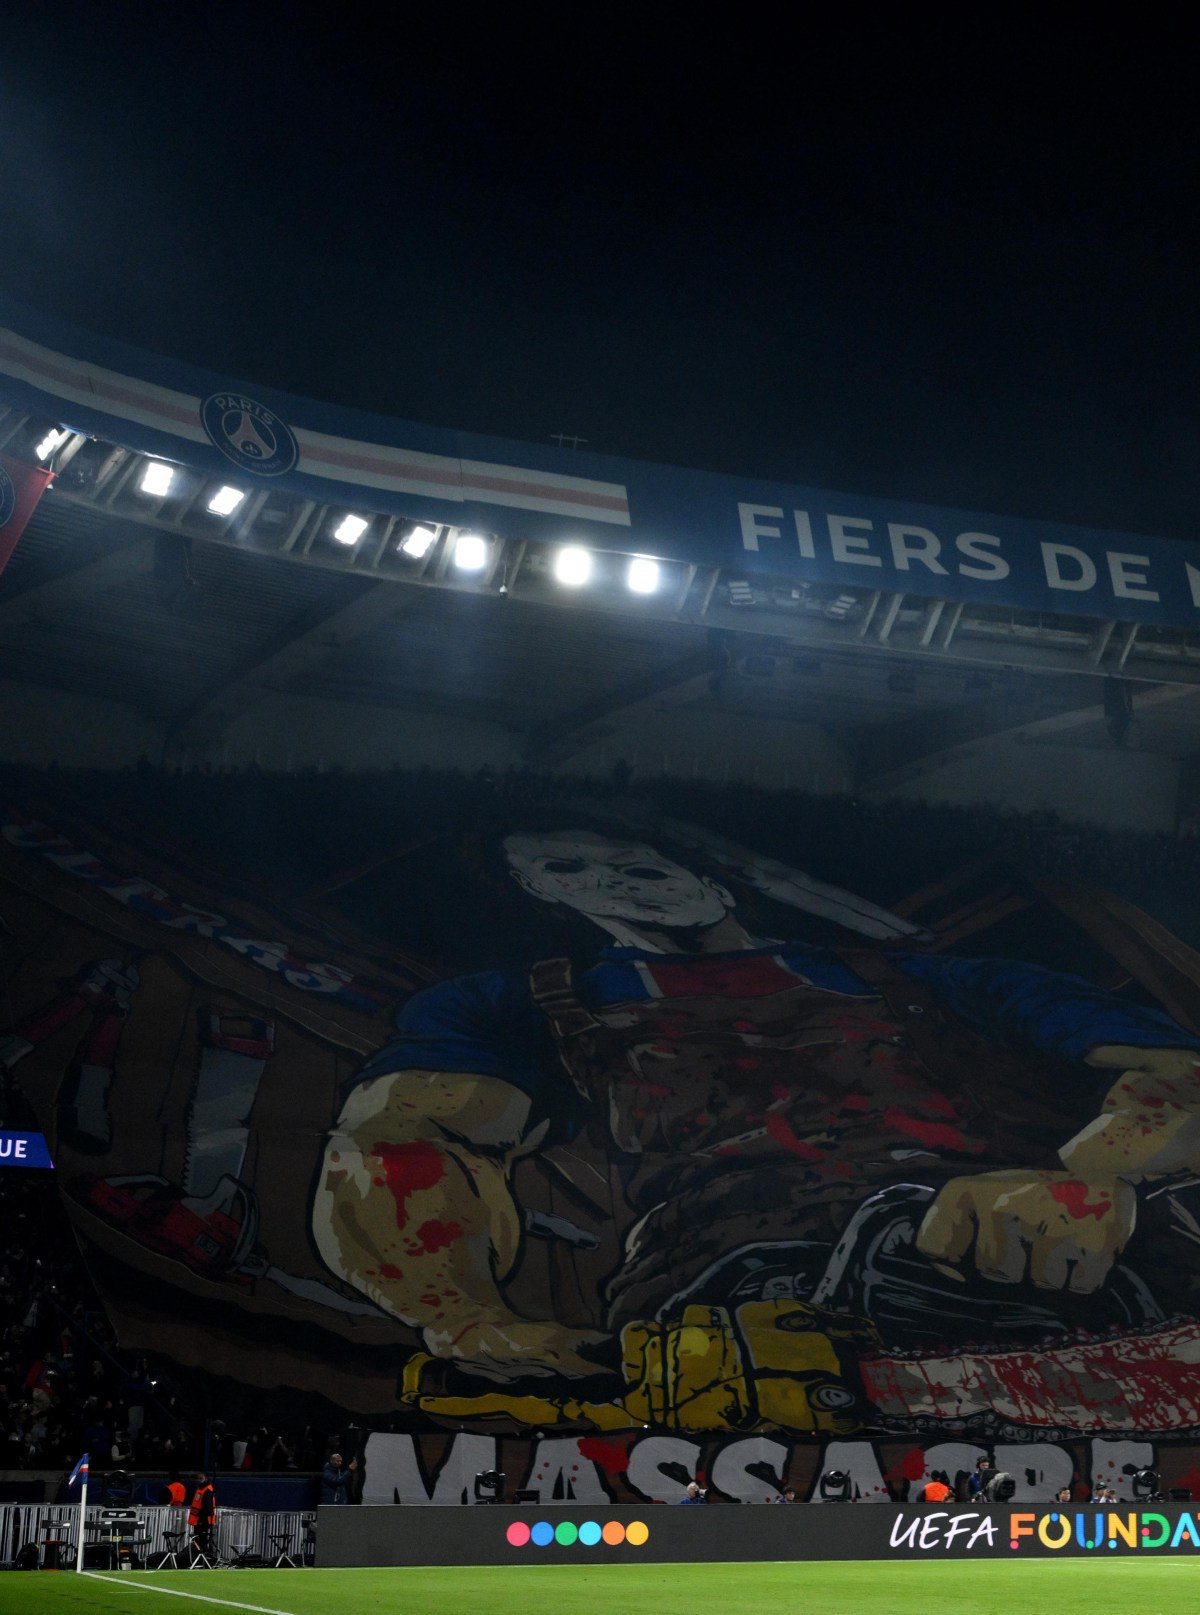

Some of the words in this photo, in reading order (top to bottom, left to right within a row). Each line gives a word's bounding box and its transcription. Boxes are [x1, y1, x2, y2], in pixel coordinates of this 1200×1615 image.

[214, 396, 275, 425] PARIS
[737, 502, 1010, 581] FIERS
[1040, 542, 1160, 602] DE
[889, 1511, 999, 1550] UEFA
